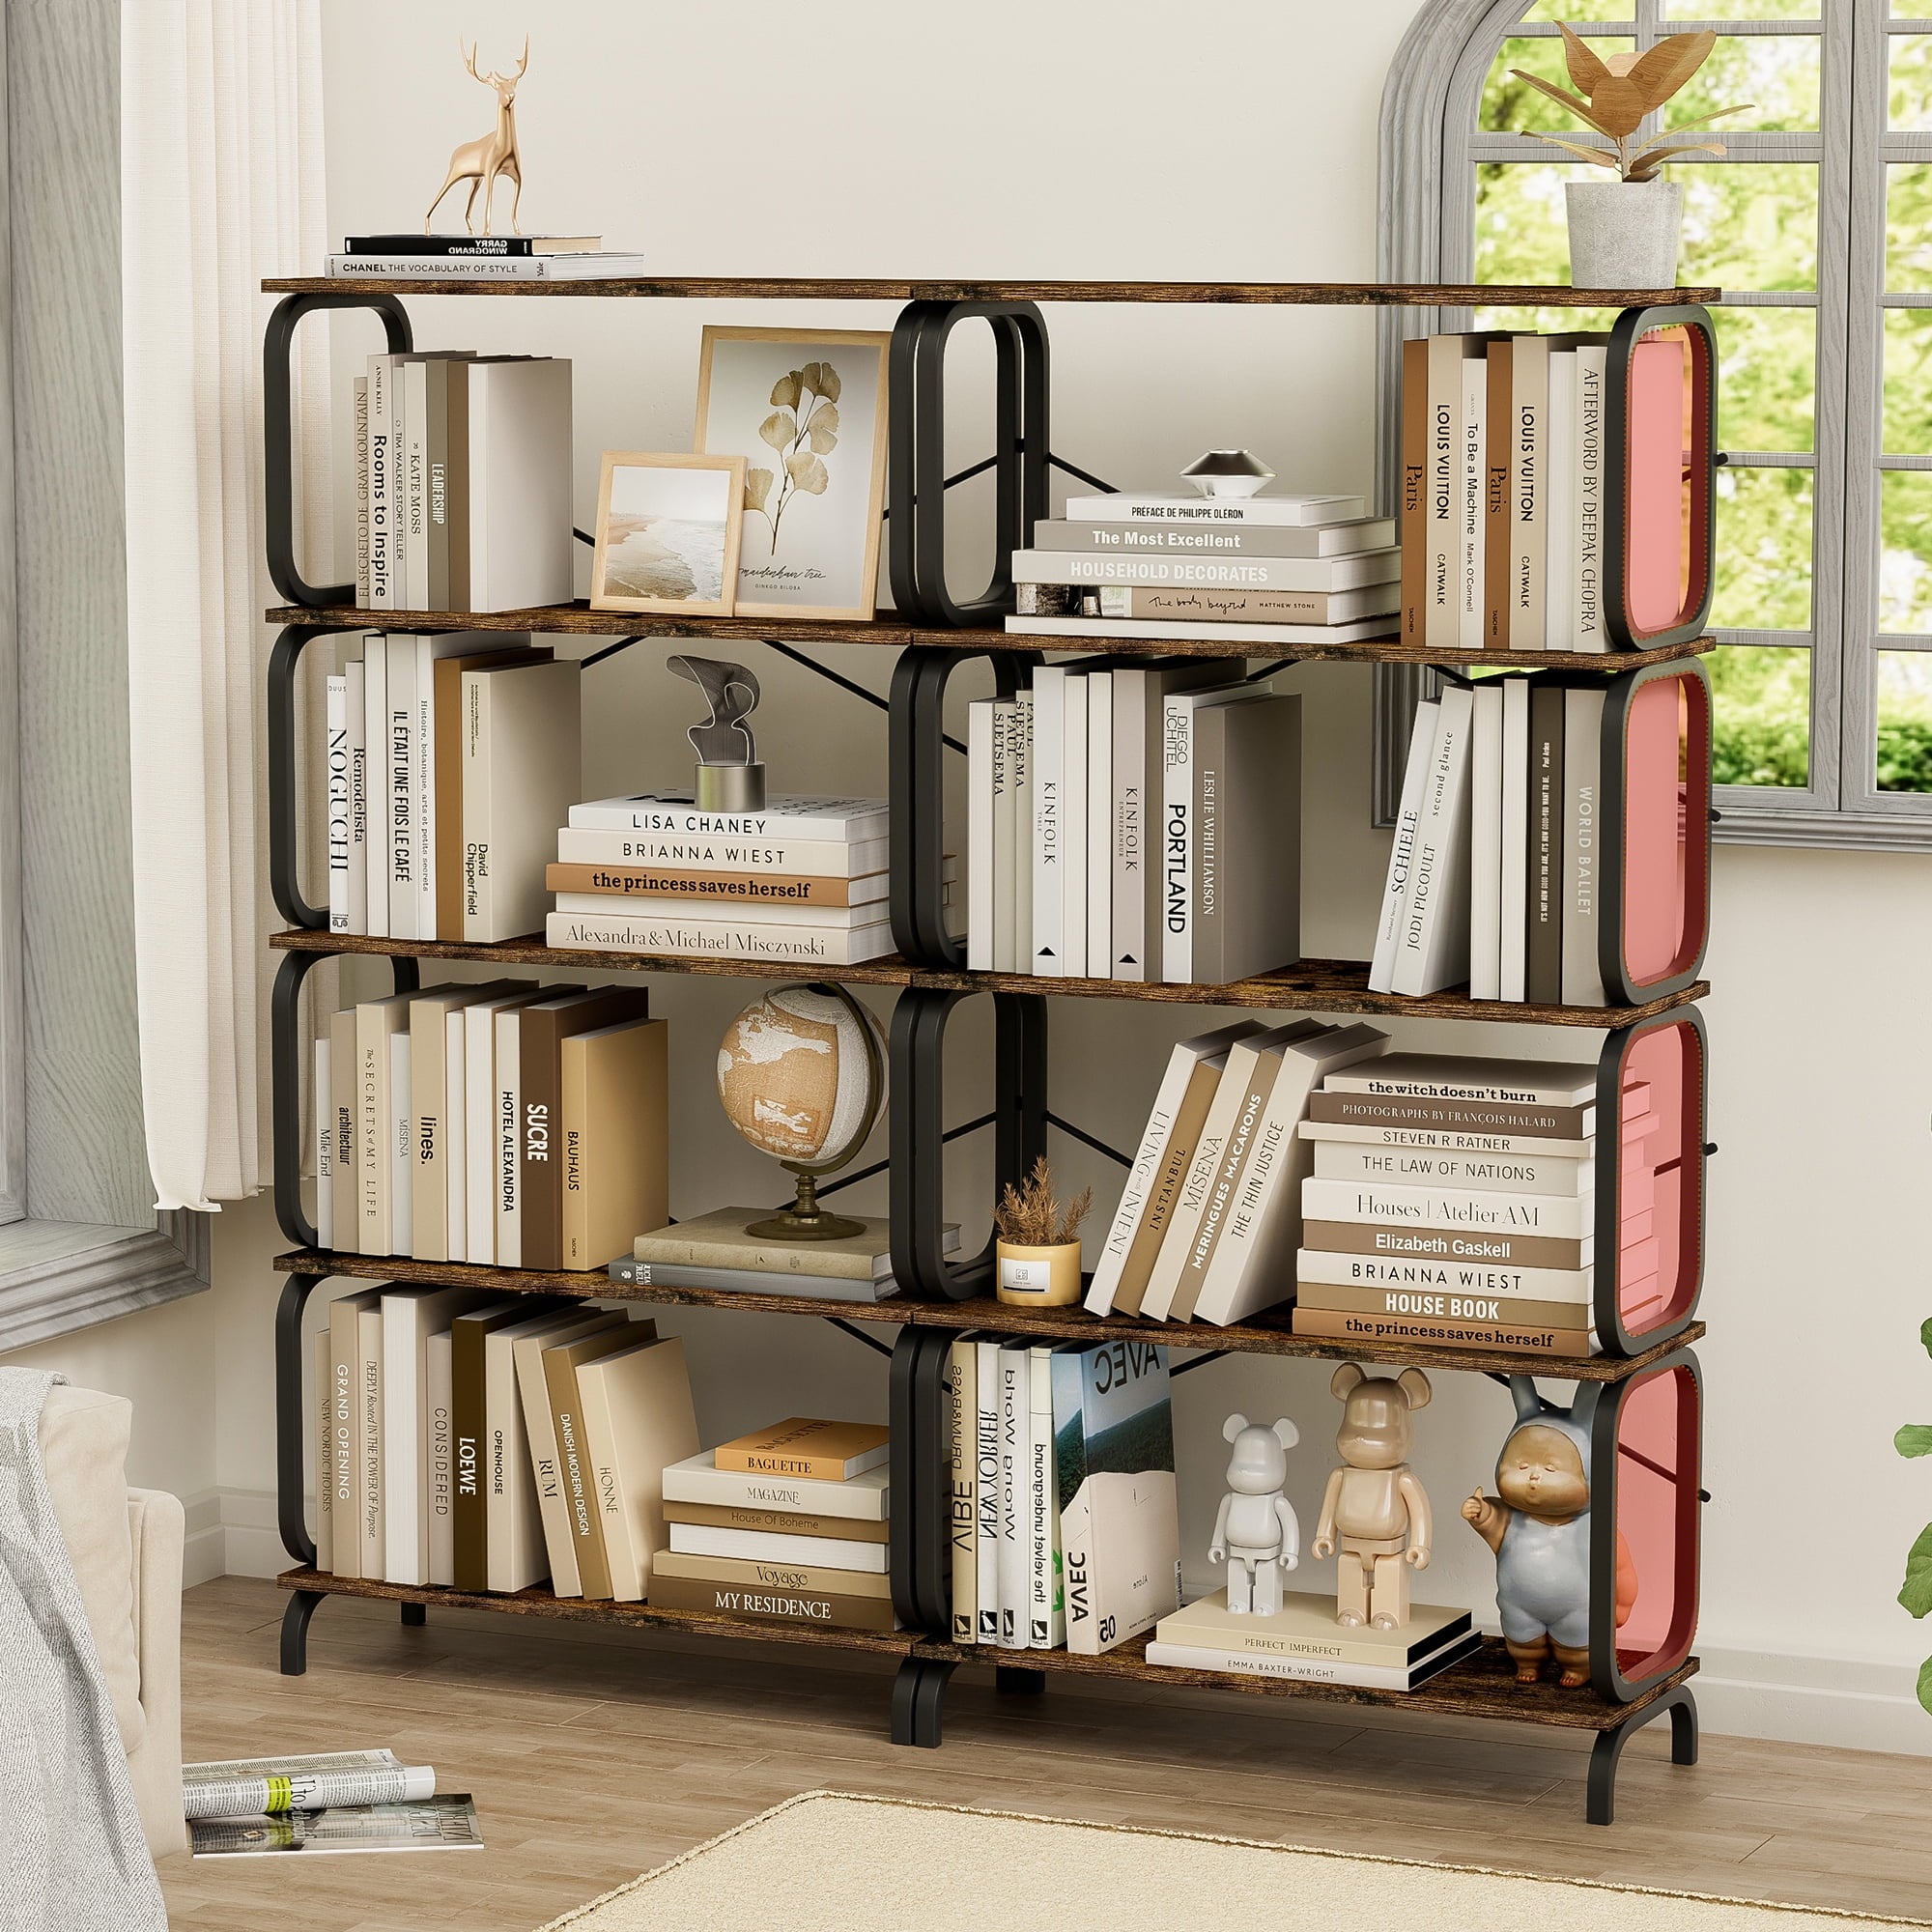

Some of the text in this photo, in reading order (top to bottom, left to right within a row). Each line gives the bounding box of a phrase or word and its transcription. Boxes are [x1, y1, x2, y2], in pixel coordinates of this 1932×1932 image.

[342, 263, 386, 272] CHANEL
[387, 264, 407, 272] THE
[408, 264, 471, 272] VOCABULARY
[472, 265, 487, 273] OF
[489, 265, 518, 273] STYLE
[536, 262, 545, 277] Yale
[1467, 423, 1478, 439] To
[1467, 443, 1478, 462] Be
[1406, 464, 1423, 511] Paris
[1435, 405, 1450, 520] LOUIS VUITTON
[356, 392, 370, 598] EL SECRETO DE GRAY MOUNTAIN
[370, 435, 389, 597] Rooms to Inspire
[395, 494, 404, 526] STORY
[411, 454, 421, 534] KATE MOSS
[432, 464, 444, 525] LEADERSHIP
[1166, 507, 1177, 518] DE
[1179, 507, 1212, 519] PHILIPPE
[1466, 478, 1478, 535] Machine
[1580, 368, 1599, 633] AFTERWORD BY DEEPAK CHOPRA
[1092, 530, 1241, 548] The Most Excellent
[1070, 561, 1268, 582] HOUSEHOLD DECORATES
[1436, 554, 1446, 605] CATWALK
[1465, 567, 1475, 612] O'Connell
[994, 713, 1005, 796] SIETSEMA
[1166, 706, 1178, 773] UCHITEL
[1177, 715, 1188, 764] DIEGO
[328, 728, 349, 870] NOGUCHI
[353, 746, 366, 843] Remodelista
[393, 711, 412, 883] IL ÉTAIT UNE FOIS LE CAFÉ
[1204, 770, 1215, 814] LESLIE
[1432, 731, 1453, 817] second glance
[633, 813, 766, 835] LISA CHANEY
[1043, 781, 1056, 865] KINFOLK
[1125, 787, 1138, 871] KINFOLK
[478, 843, 489, 877] David
[623, 842, 784, 865] BRIANNA WIEST
[1168, 804, 1186, 934] PORTLAND
[1391, 810, 1418, 895] SCHIELE
[1577, 786, 1593, 916] WORLD BALLET
[465, 842, 478, 916] Chipperfield
[1406, 843, 1435, 951] JODI PICOULT
[1343, 1104, 1555, 1127] PHOTOGRAPHS BY FRANÇOIS HALARD
[1368, 1081, 1537, 1102] the witch doesn't burn
[320, 1128, 332, 1177] Mile End
[338, 1106, 353, 1166] architectuur
[420, 1117, 438, 1165] lines.
[502, 1091, 515, 1212] HOTEL ALEXANDRA
[526, 1103, 549, 1162] SUCRE
[1382, 1130, 1511, 1151] STEVEN R RATNER
[567, 1131, 580, 1191] BAUHAUS
[1191, 1094, 1263, 1269] MERINGUES MACARONS
[1231, 1121, 1284, 1238] THE THIN JUSTICE
[1361, 1155, 1535, 1181] THE LAW OF NATIONS
[1150, 1149, 1186, 1232] INSTANBUL
[1376, 1233, 1510, 1258] Elizabeth Gaskell
[1351, 1263, 1521, 1291] BRIANNA WIEST
[1385, 1293, 1499, 1320] HOUSE BOOK
[1345, 1319, 1555, 1348] the princess saves herself
[321, 1398, 333, 1515] NEW NORDIC HOUSES
[337, 1364, 350, 1500] GRAND OPENING
[434, 1407, 448, 1516] CONSIDERED
[459, 1436, 476, 1495] LOEWE
[494, 1430, 503, 1495] OPENHOUSE
[538, 1459, 558, 1498] RUM
[560, 1413, 590, 1536] DANISH MODERN DESIGN
[748, 1457, 812, 1474] BAGUETTE
[599, 1467, 619, 1514] HONNE
[747, 1487, 801, 1506] MAGAZINE
[731, 1512, 819, 1530] House Of Boheme
[755, 1565, 809, 1589] Voyage
[715, 1591, 832, 1619] MY RESIDENCE
[1227, 1660, 1335, 1678] EMMA BAXTER-WRIGHT
[1244, 1637, 1343, 1657] PERFECT IMPERFECT
